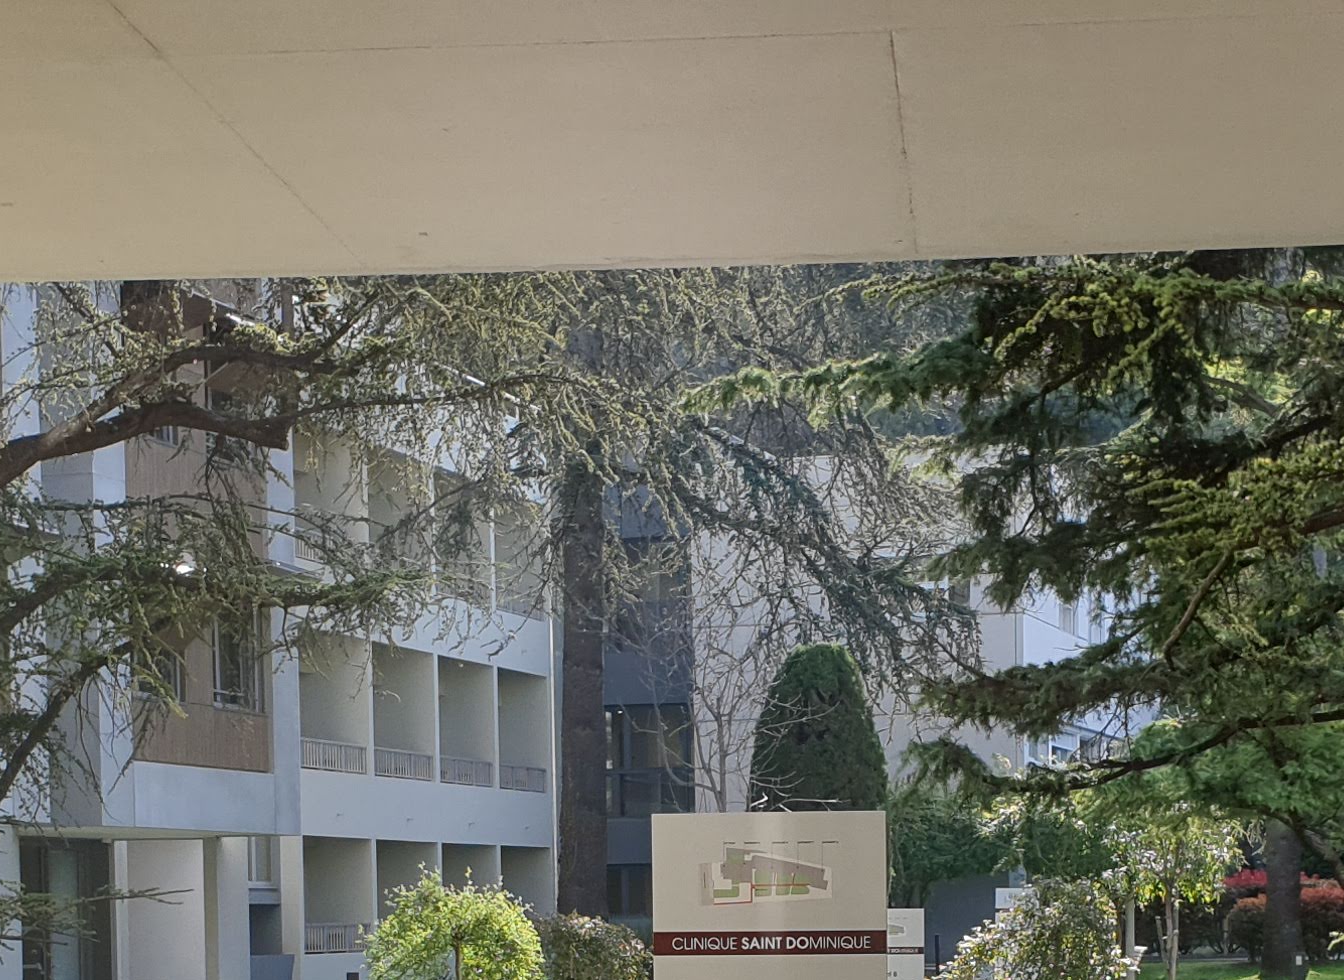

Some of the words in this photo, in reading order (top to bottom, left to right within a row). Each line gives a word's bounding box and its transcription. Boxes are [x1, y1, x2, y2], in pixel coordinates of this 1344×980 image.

[672, 936, 738, 951] CLINIQUE
[741, 936, 783, 950] SAINT
[785, 935, 871, 950] DOMINIQUE
